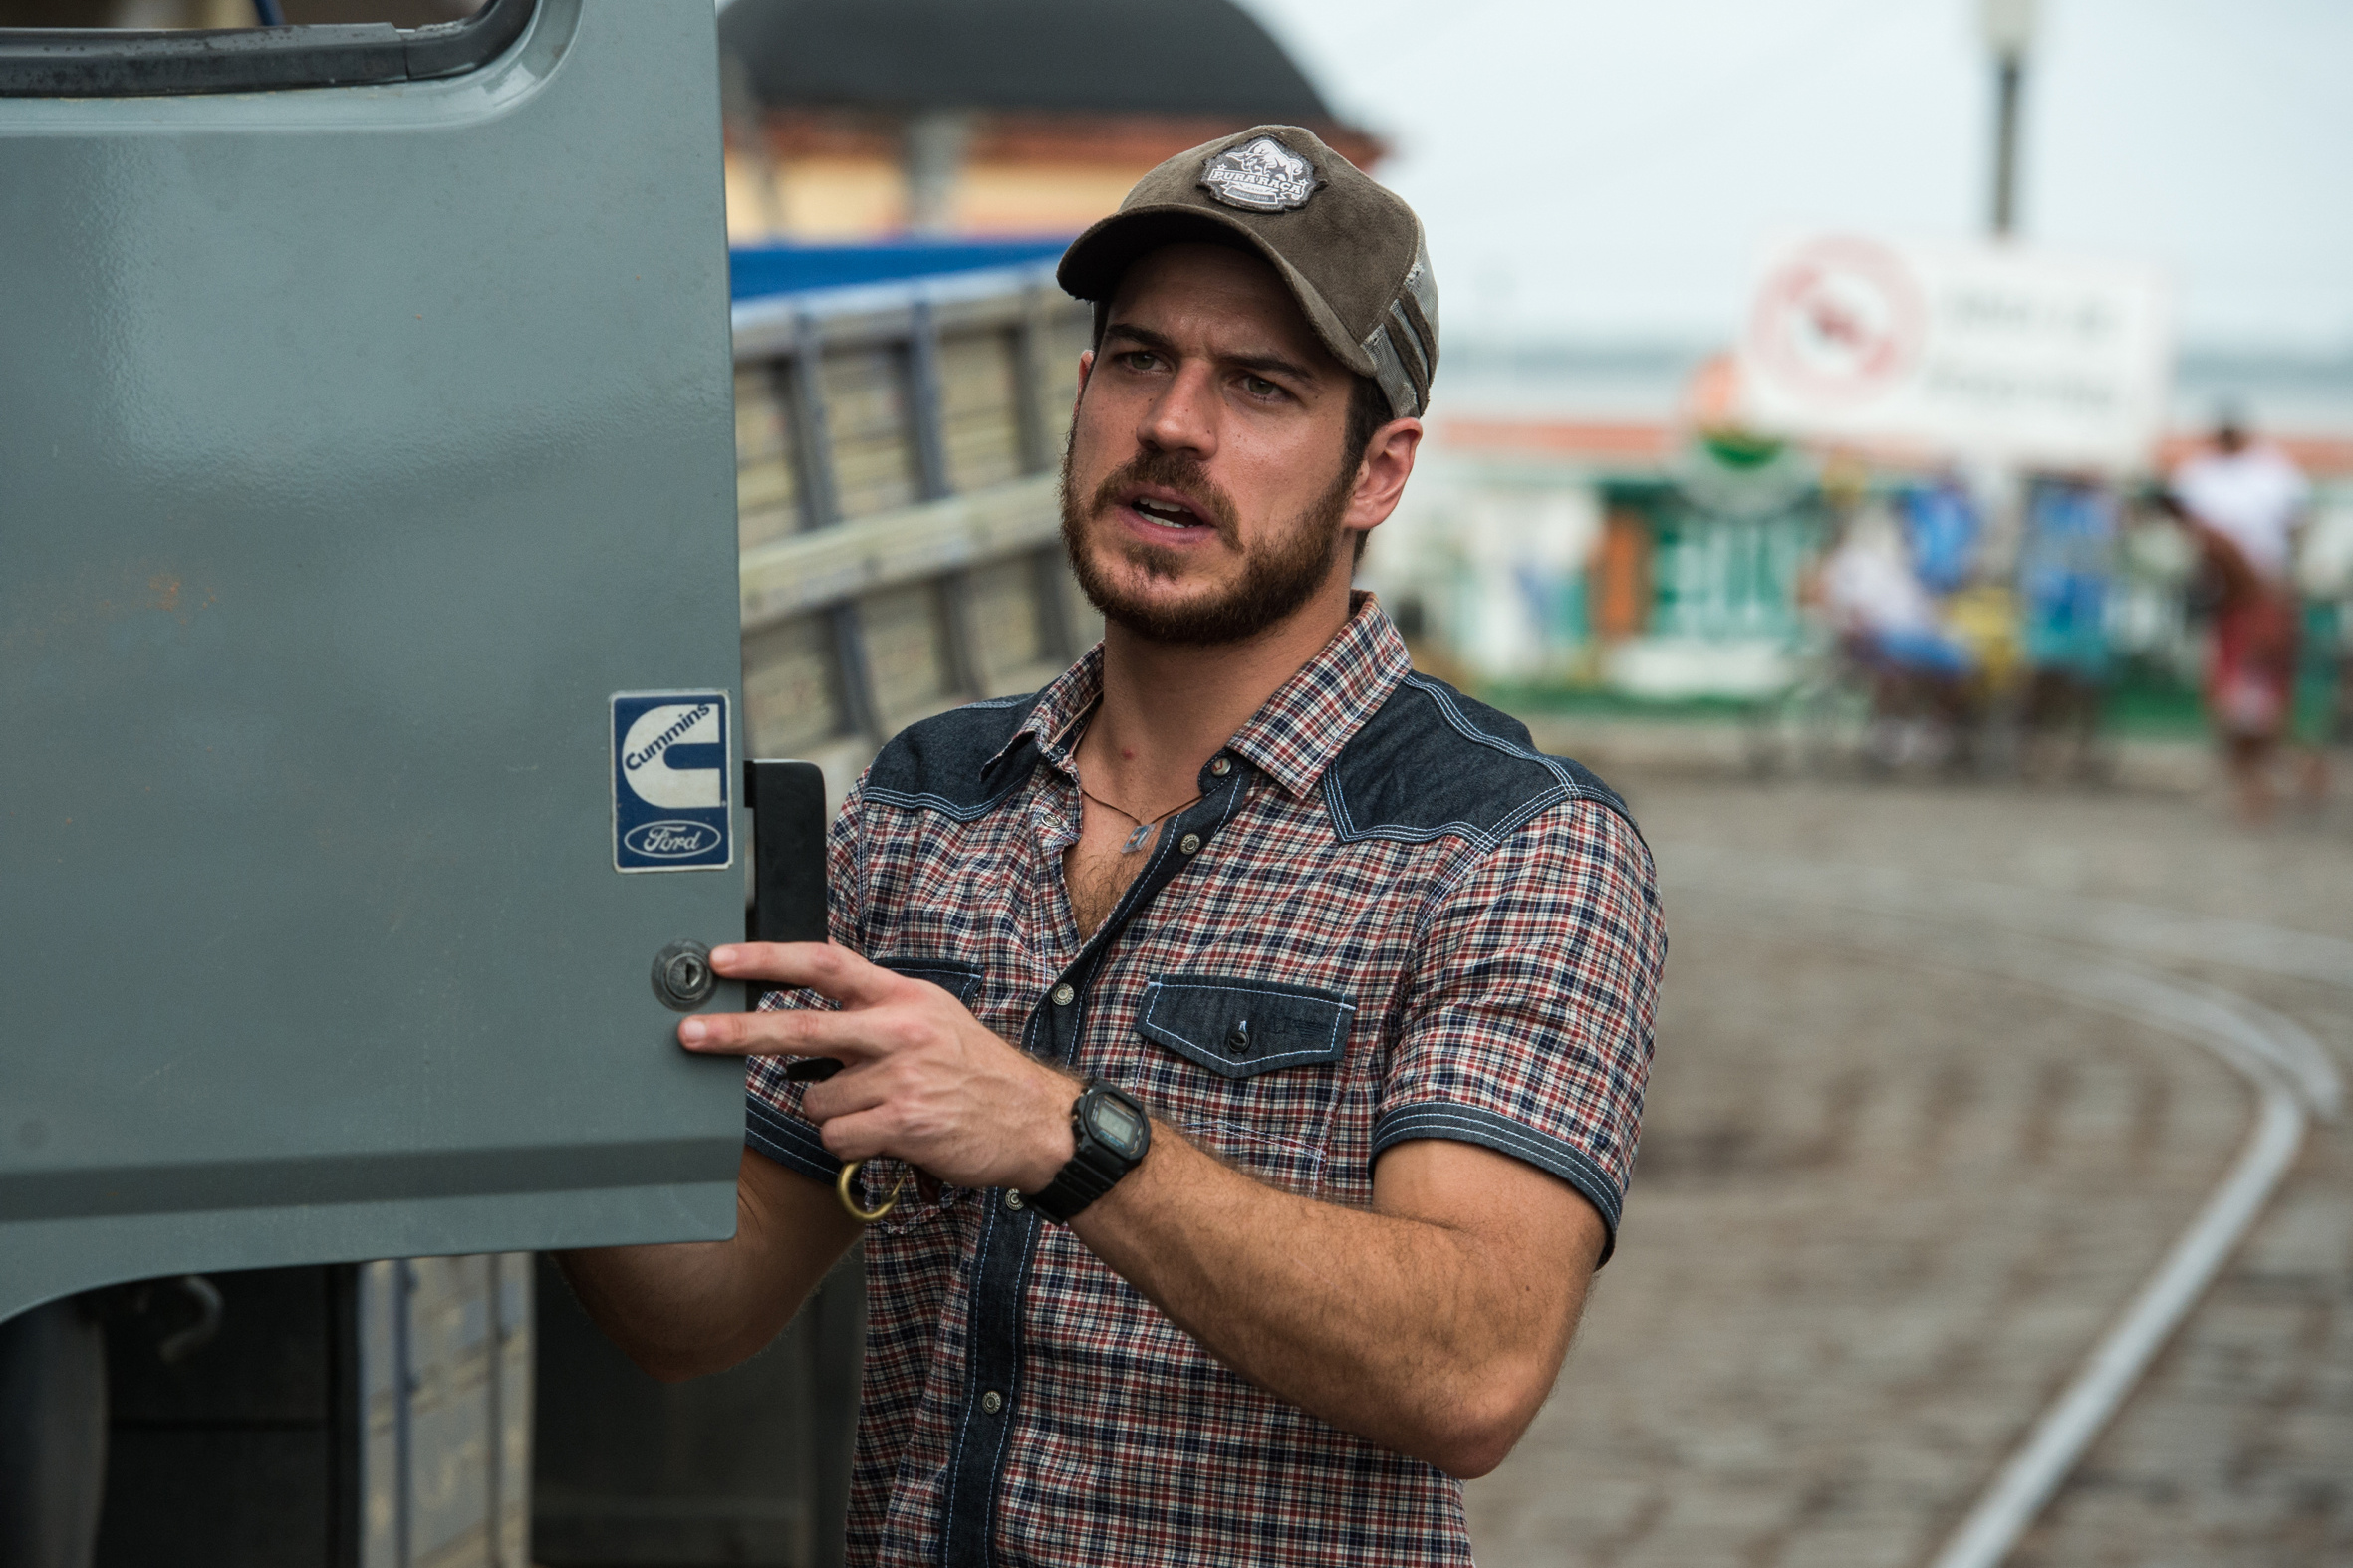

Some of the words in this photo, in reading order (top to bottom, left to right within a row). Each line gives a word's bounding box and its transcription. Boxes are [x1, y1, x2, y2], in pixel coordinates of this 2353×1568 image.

[1212, 171, 1257, 184] PURA
[1258, 176, 1301, 194] RAÇA
[626, 704, 710, 771] Cummins
[643, 825, 702, 852] Ford
